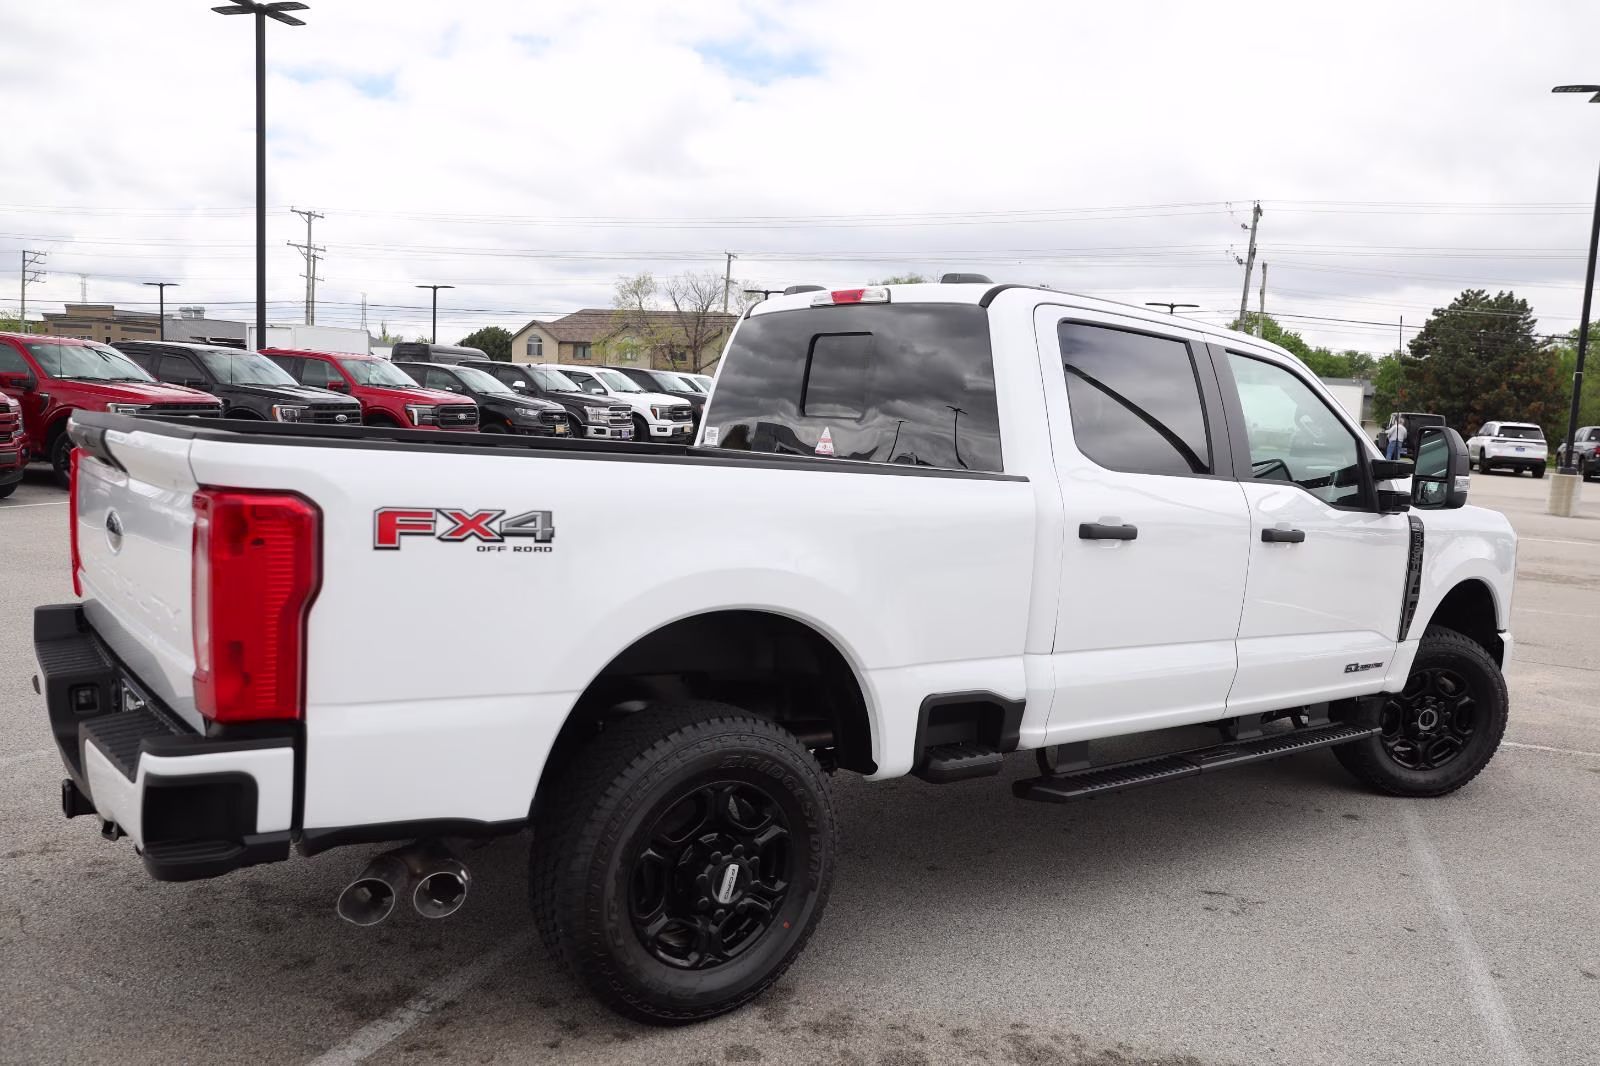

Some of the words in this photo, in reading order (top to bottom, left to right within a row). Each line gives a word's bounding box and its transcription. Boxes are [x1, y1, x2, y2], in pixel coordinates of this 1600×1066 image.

[373, 506, 555, 551] FX4
[476, 545, 508, 553] OFF
[513, 545, 553, 553] ROAD
